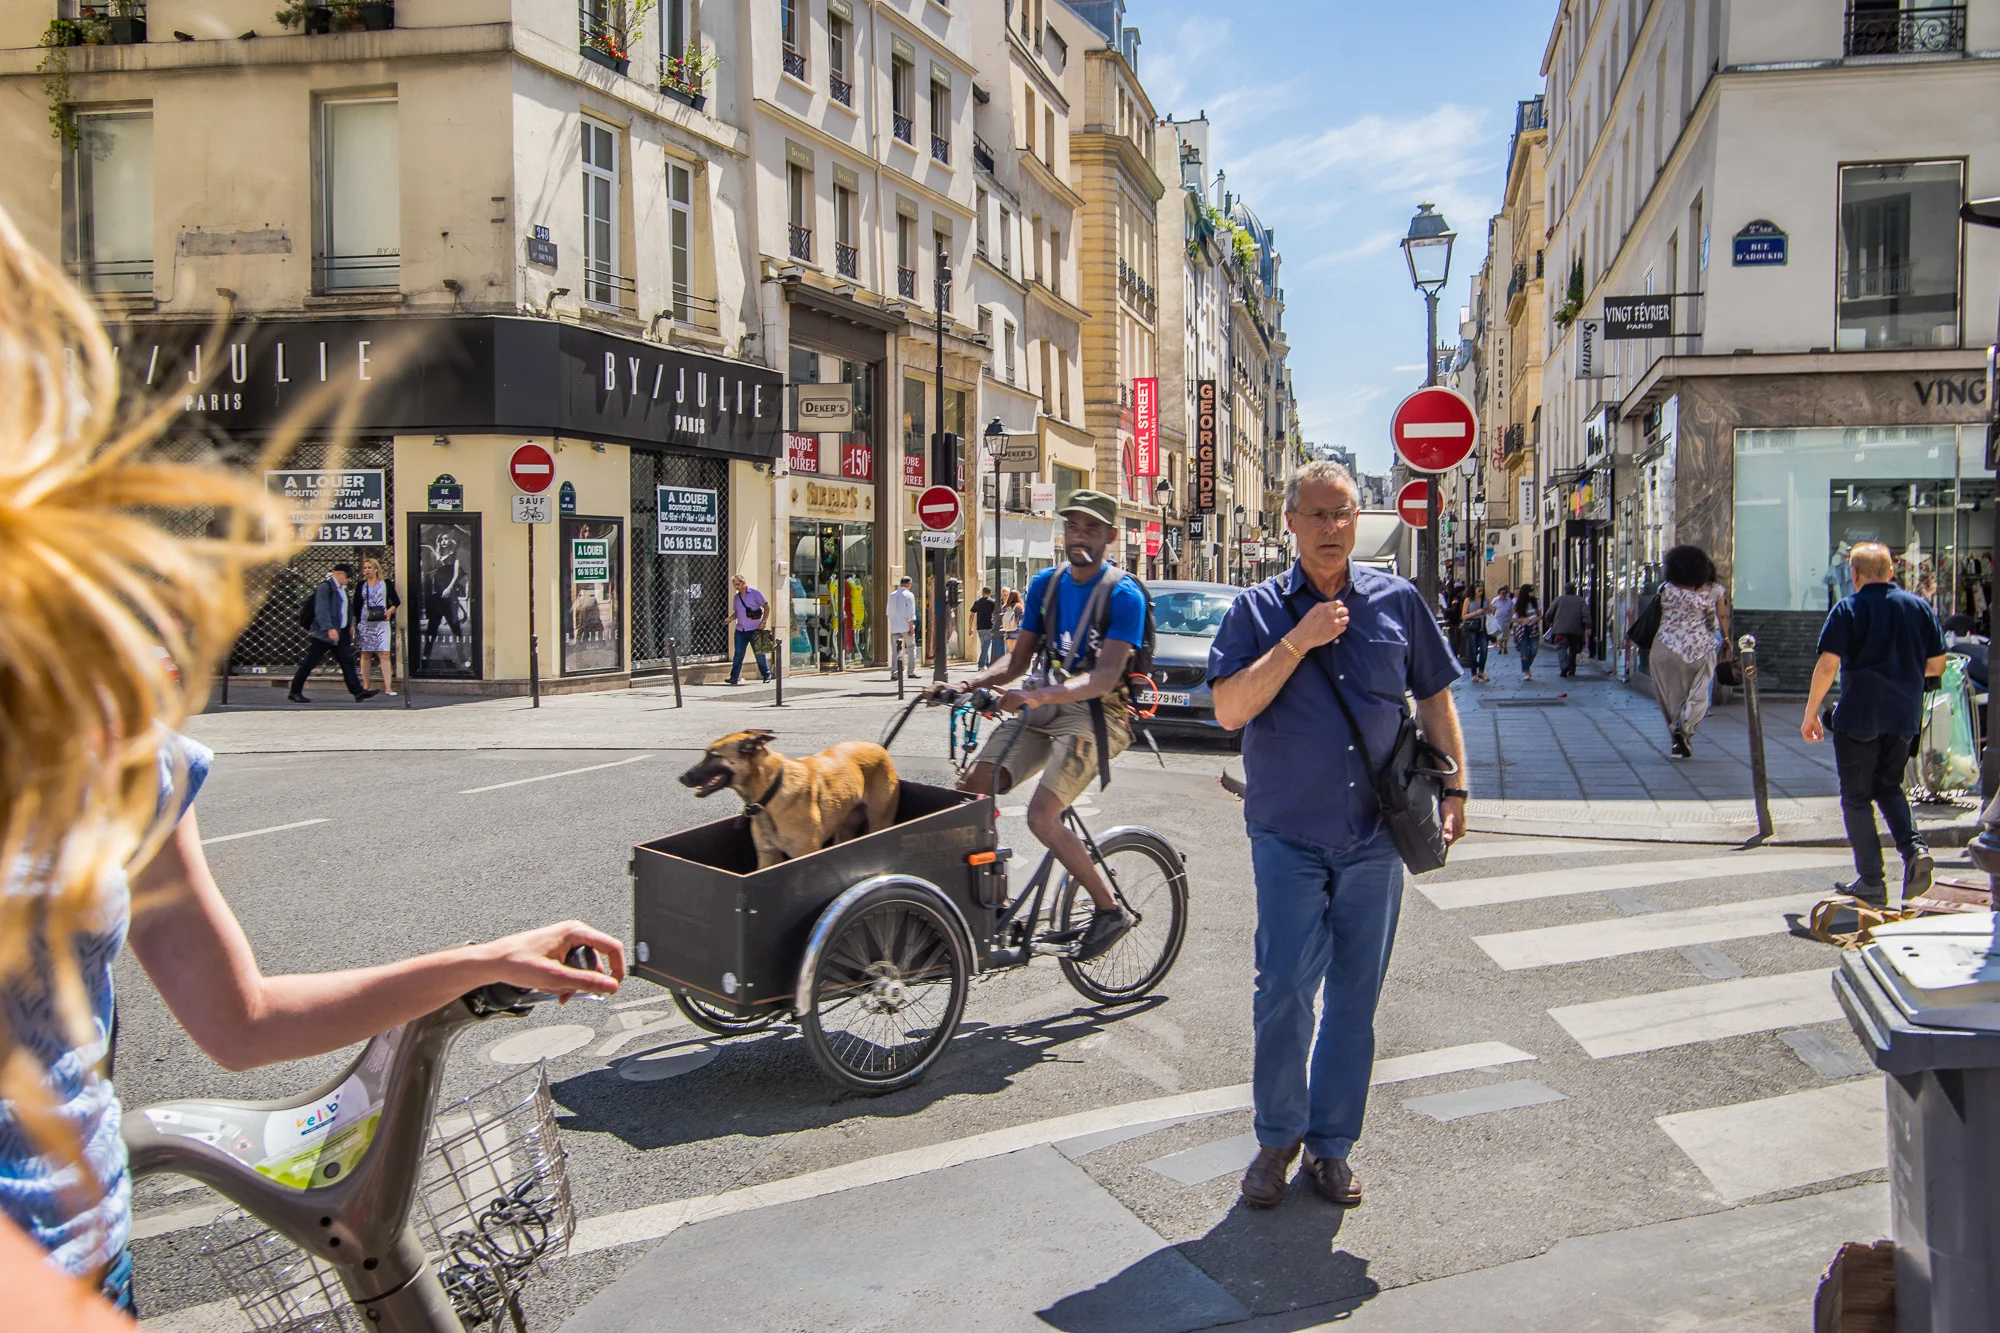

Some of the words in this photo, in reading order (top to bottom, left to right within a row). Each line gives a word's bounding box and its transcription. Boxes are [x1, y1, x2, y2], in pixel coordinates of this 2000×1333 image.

[536, 226, 549, 241] 248
[1750, 242, 1770, 251] RUE
[1736, 252, 1784, 261] D'ABOUKIR
[1605, 306, 1633, 323] VINGT
[1635, 302, 1670, 322] FÉVRIER
[1626, 322, 1654, 330] PARIS
[604, 351, 762, 418] BY/JULIE
[184, 393, 243, 411] PARIS
[805, 402, 845, 413] DEKER'S
[1137, 380, 1149, 429] STREET
[674, 414, 706, 435] PARIS
[789, 435, 813, 452] ROBE
[1200, 383, 1214, 508] GEORGEDE
[1138, 431, 1150, 474] MERYL
[284, 476, 298, 488] A
[306, 475, 365, 488] LOUER
[284, 489, 332, 499] BOUTIQUE
[668, 492, 676, 503] A
[679, 493, 708, 505] LOUER
[361, 499, 371, 508] 40
[518, 497, 545, 505] SAUF
[325, 512, 374, 520] IMMOBILIER
[318, 526, 333, 540] 13
[335, 526, 351, 540] 15
[353, 525, 373, 540] 42
[922, 535, 941, 543] SAUF
[663, 536, 675, 549] 06
[676, 536, 685, 549] 16
[685, 537, 693, 549] 13
[694, 537, 702, 550] 15
[702, 537, 713, 550] 42
[577, 545, 583, 556] A
[583, 545, 604, 556] LOUER
